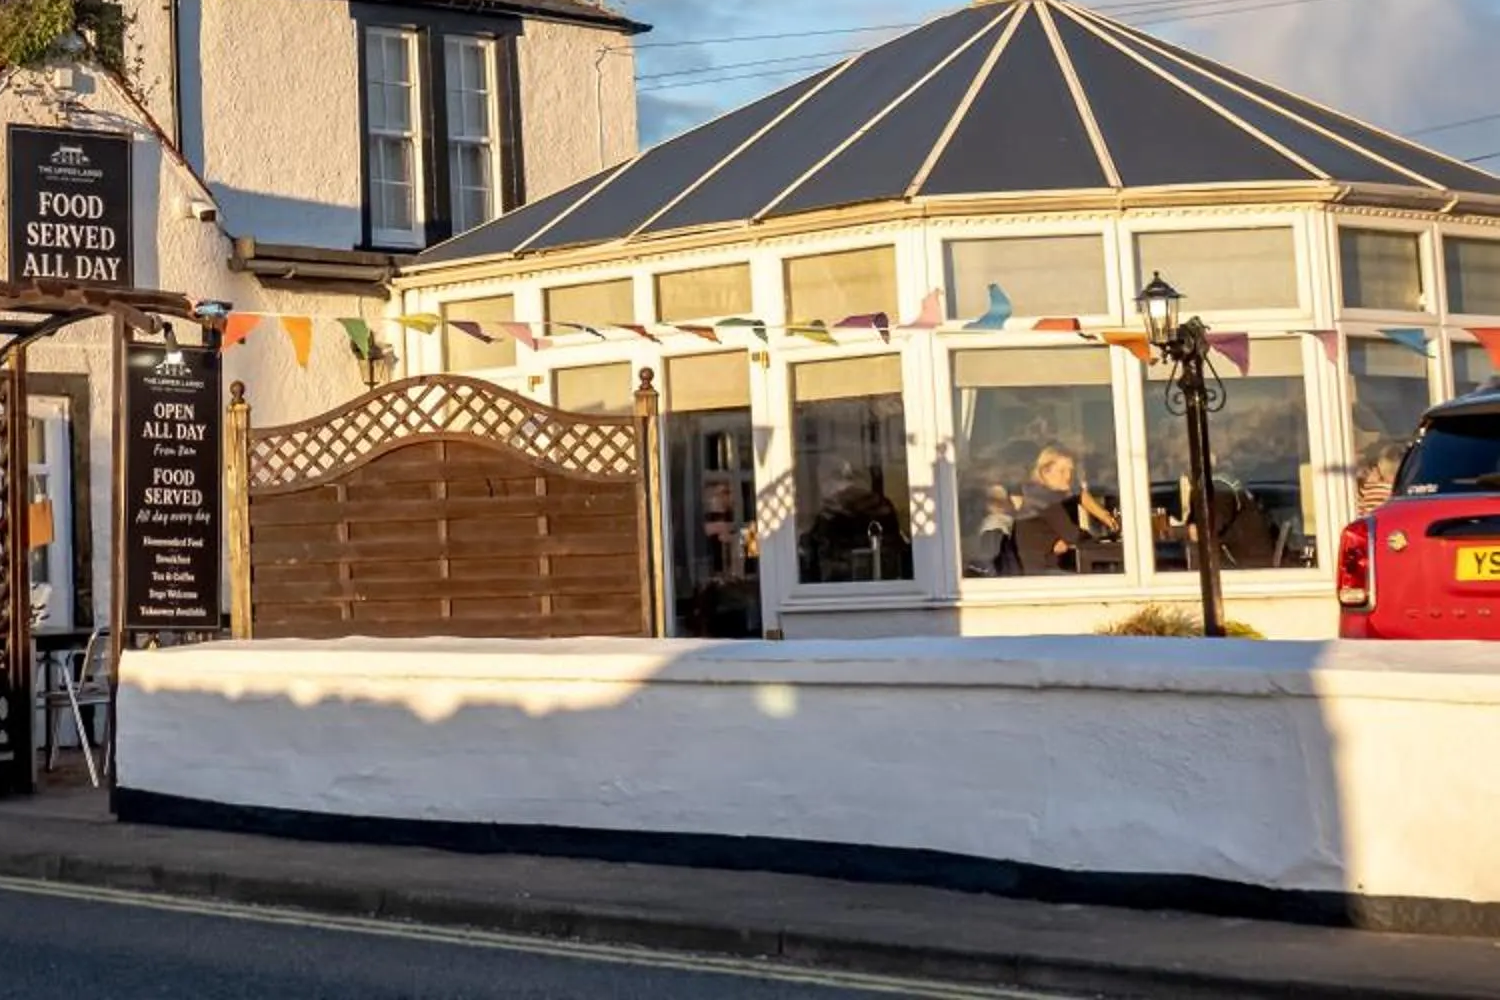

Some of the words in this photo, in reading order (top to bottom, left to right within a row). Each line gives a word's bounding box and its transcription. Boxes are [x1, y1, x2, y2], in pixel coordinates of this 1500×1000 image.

[38, 191, 104, 219] FOOD
[26, 221, 116, 251] SERVED
[22, 252, 69, 279] ALL
[75, 255, 122, 281] DAY
[153, 402, 195, 421] OPEN
[142, 421, 173, 439] ALL
[176, 423, 207, 441] DAY
[153, 443, 176, 457] From
[153, 467, 195, 486] FOOD
[144, 487, 204, 507] SERVED
[135, 509, 151, 524] All
[152, 509, 168, 526] day
[170, 513, 193, 526] every
[194, 508, 211, 526] day
[155, 554, 191, 565] Breakfast
[151, 571, 164, 581] Tea
[173, 572, 195, 582] Coffee
[148, 588, 166, 600] Dogs
[167, 589, 198, 600] Welcome
